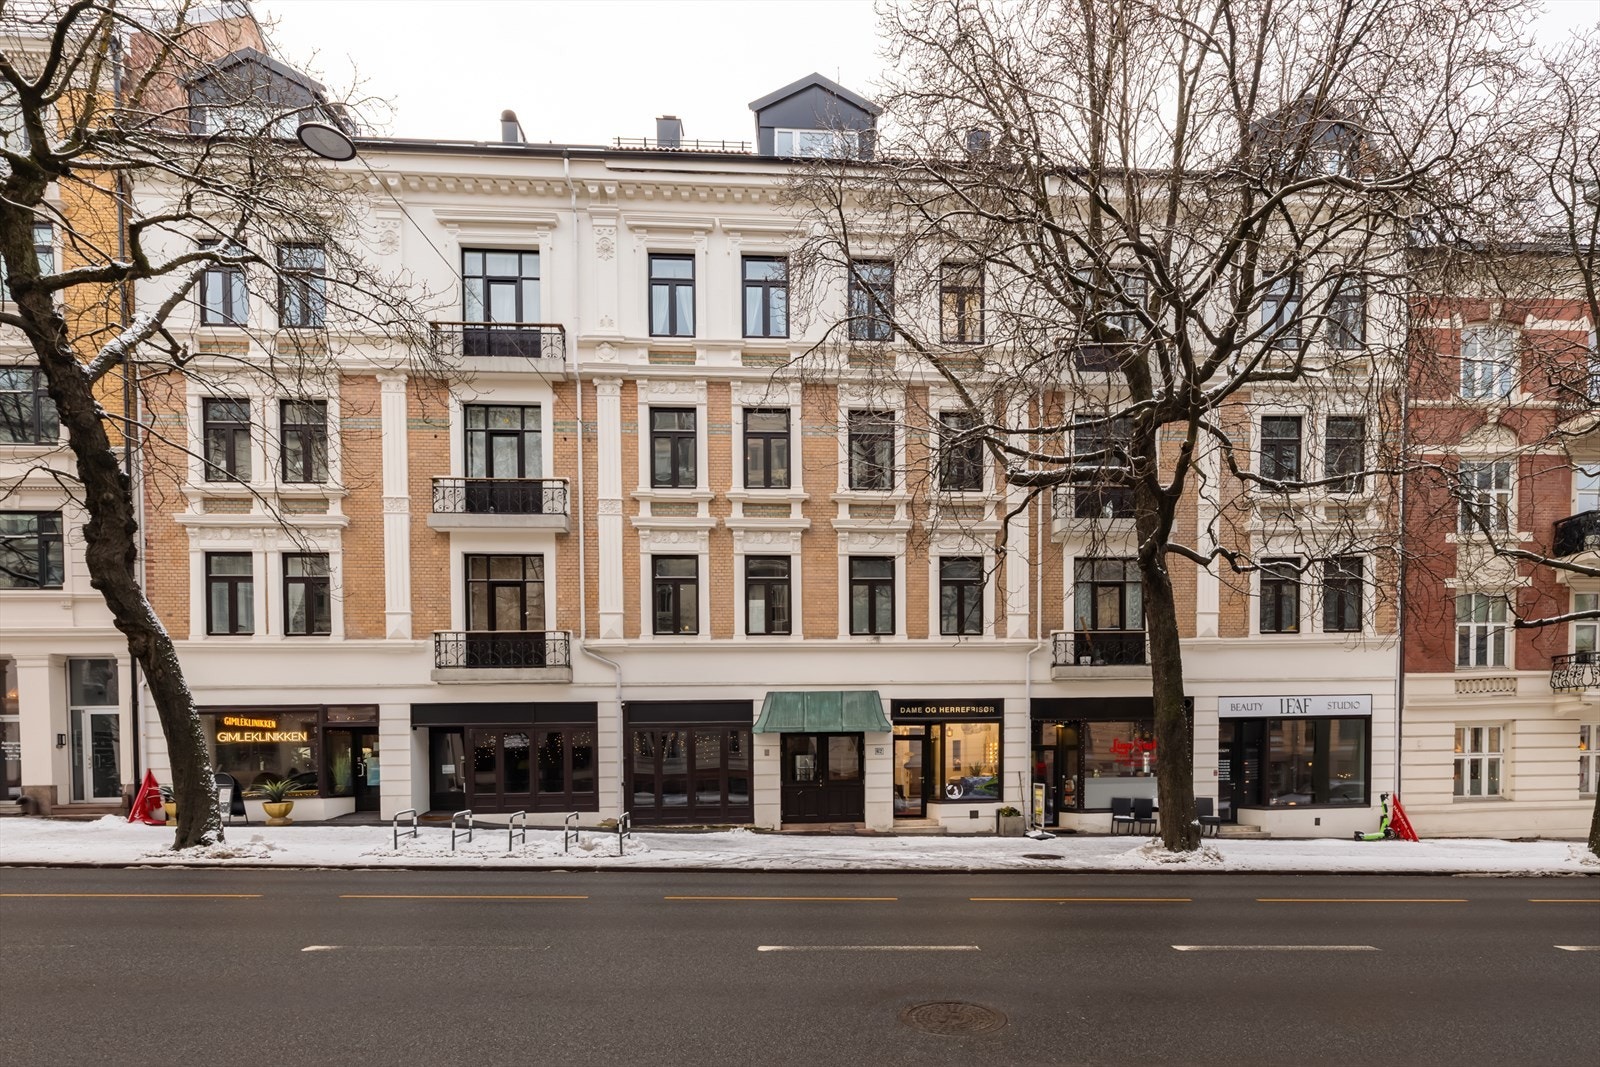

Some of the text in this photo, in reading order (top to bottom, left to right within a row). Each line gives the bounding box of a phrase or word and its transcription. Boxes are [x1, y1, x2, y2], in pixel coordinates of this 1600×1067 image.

[1230, 703, 1263, 711] BEAUTY
[1327, 701, 1360, 710] STUDIO
[224, 717, 276, 729] GIMLEKLINIKKEN
[217, 732, 307, 742] GIMLEKLINIKKEN
